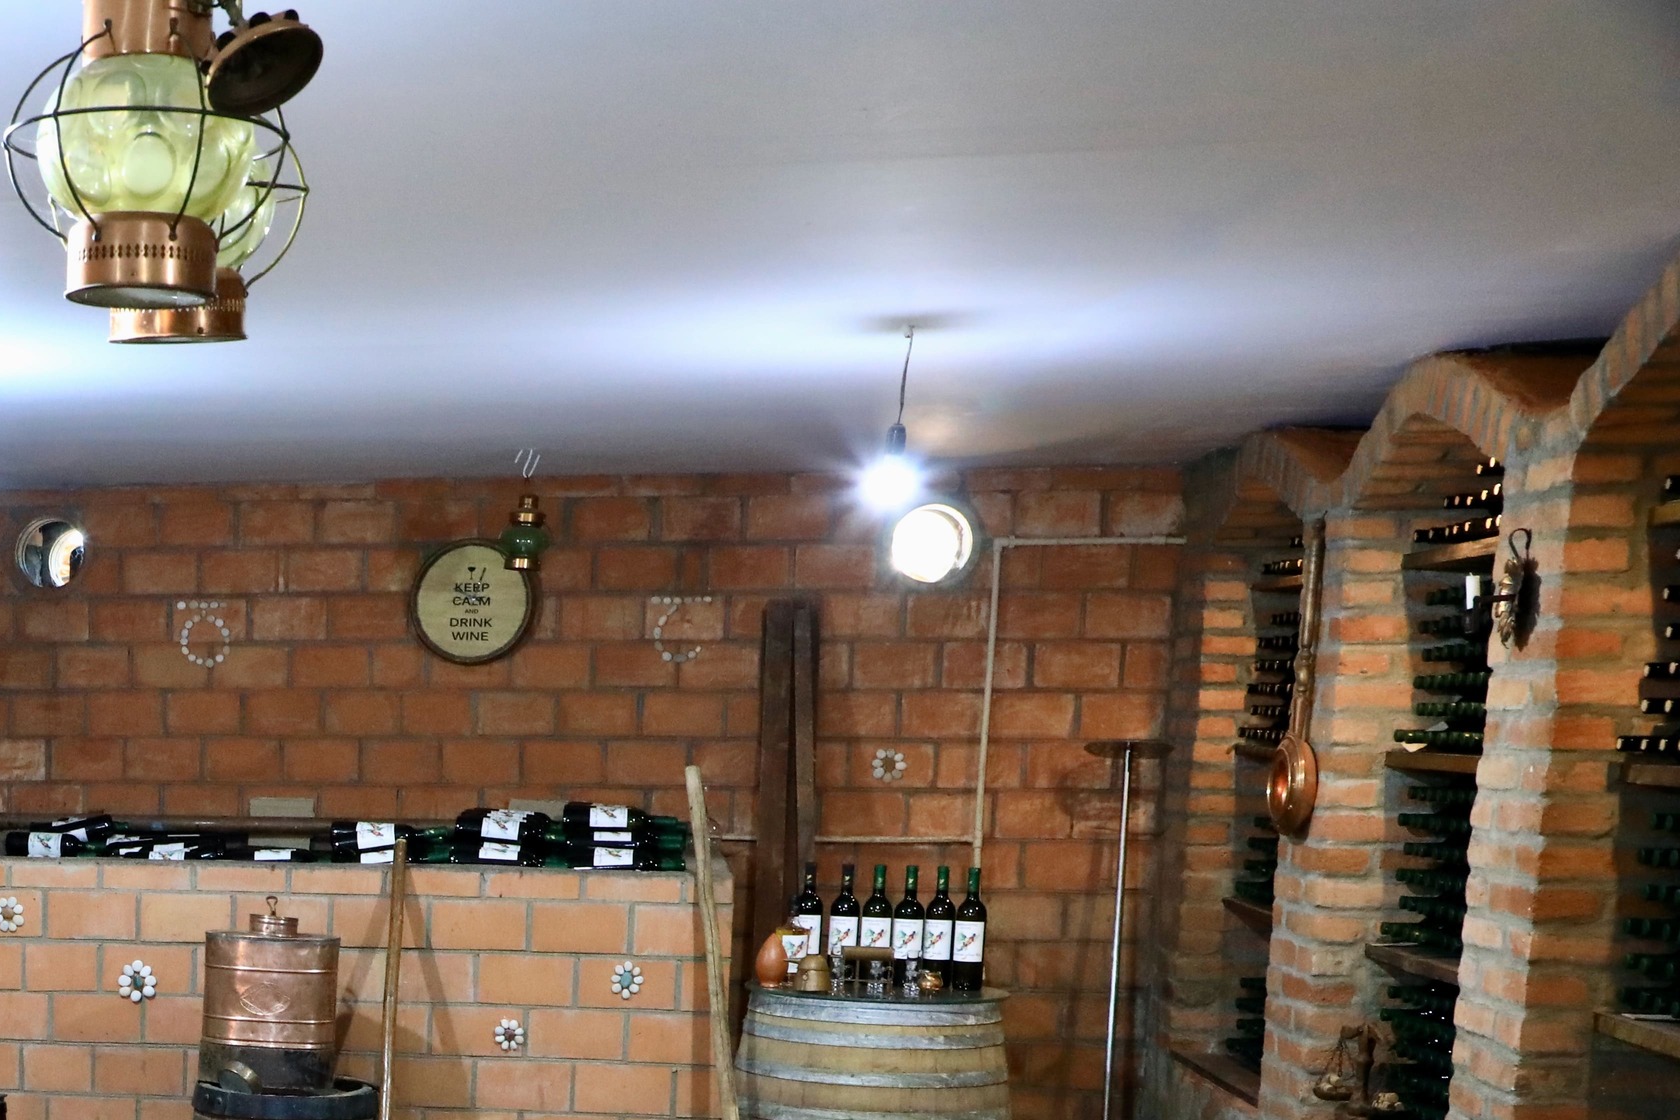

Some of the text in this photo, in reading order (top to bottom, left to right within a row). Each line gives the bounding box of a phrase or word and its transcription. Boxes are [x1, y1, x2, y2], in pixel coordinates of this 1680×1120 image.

[454, 582, 490, 593] KEEP
[449, 617, 492, 627] DRINK
[451, 631, 488, 641] WINE
